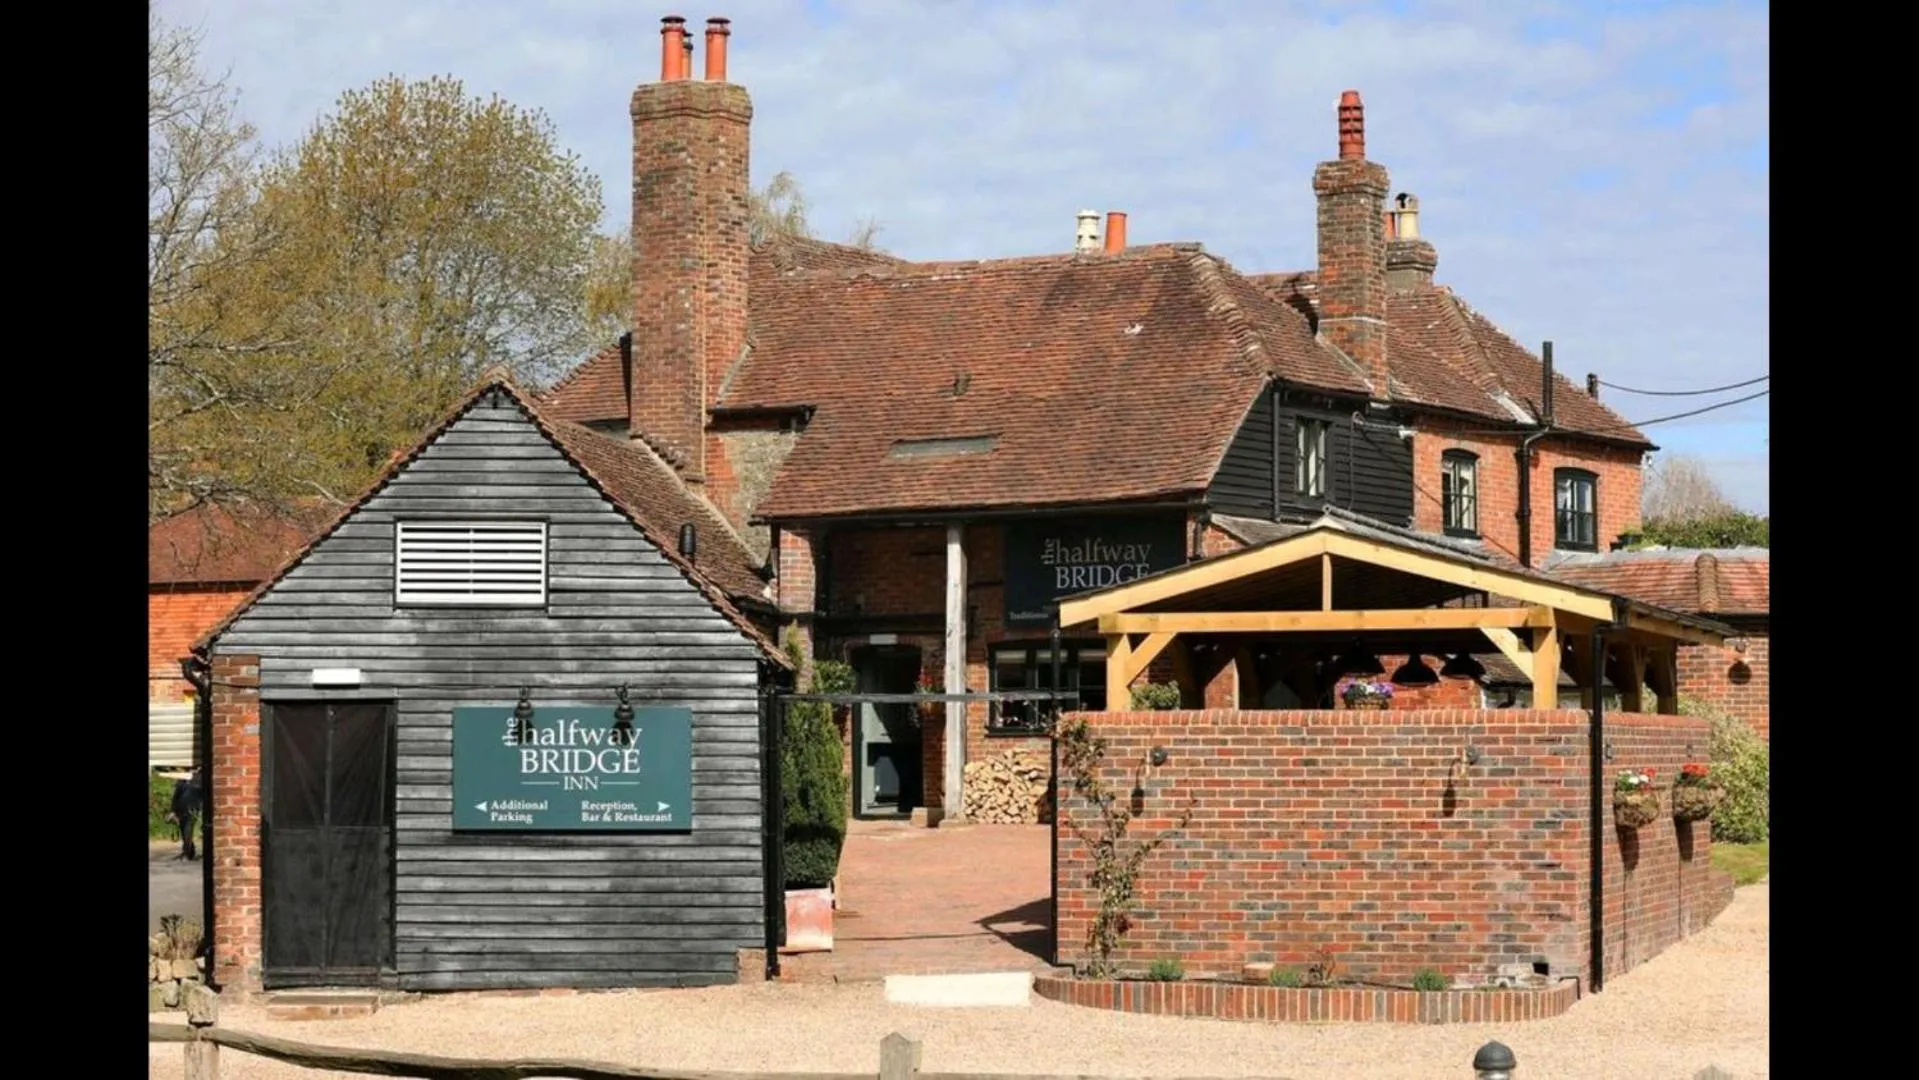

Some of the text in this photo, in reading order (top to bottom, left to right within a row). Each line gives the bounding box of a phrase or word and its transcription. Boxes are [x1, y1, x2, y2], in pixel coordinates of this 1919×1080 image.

[1040, 537, 1152, 565] the halfway
[1056, 563, 1150, 589] BRIDGE
[502, 717, 643, 750] the halfway
[521, 749, 641, 773] BRIDGE
[563, 775, 599, 790] INN
[491, 800, 548, 811] Additional
[581, 800, 638, 814] Reception,
[491, 813, 533, 824] Parking
[581, 812, 672, 822] Bar & Restaurant
